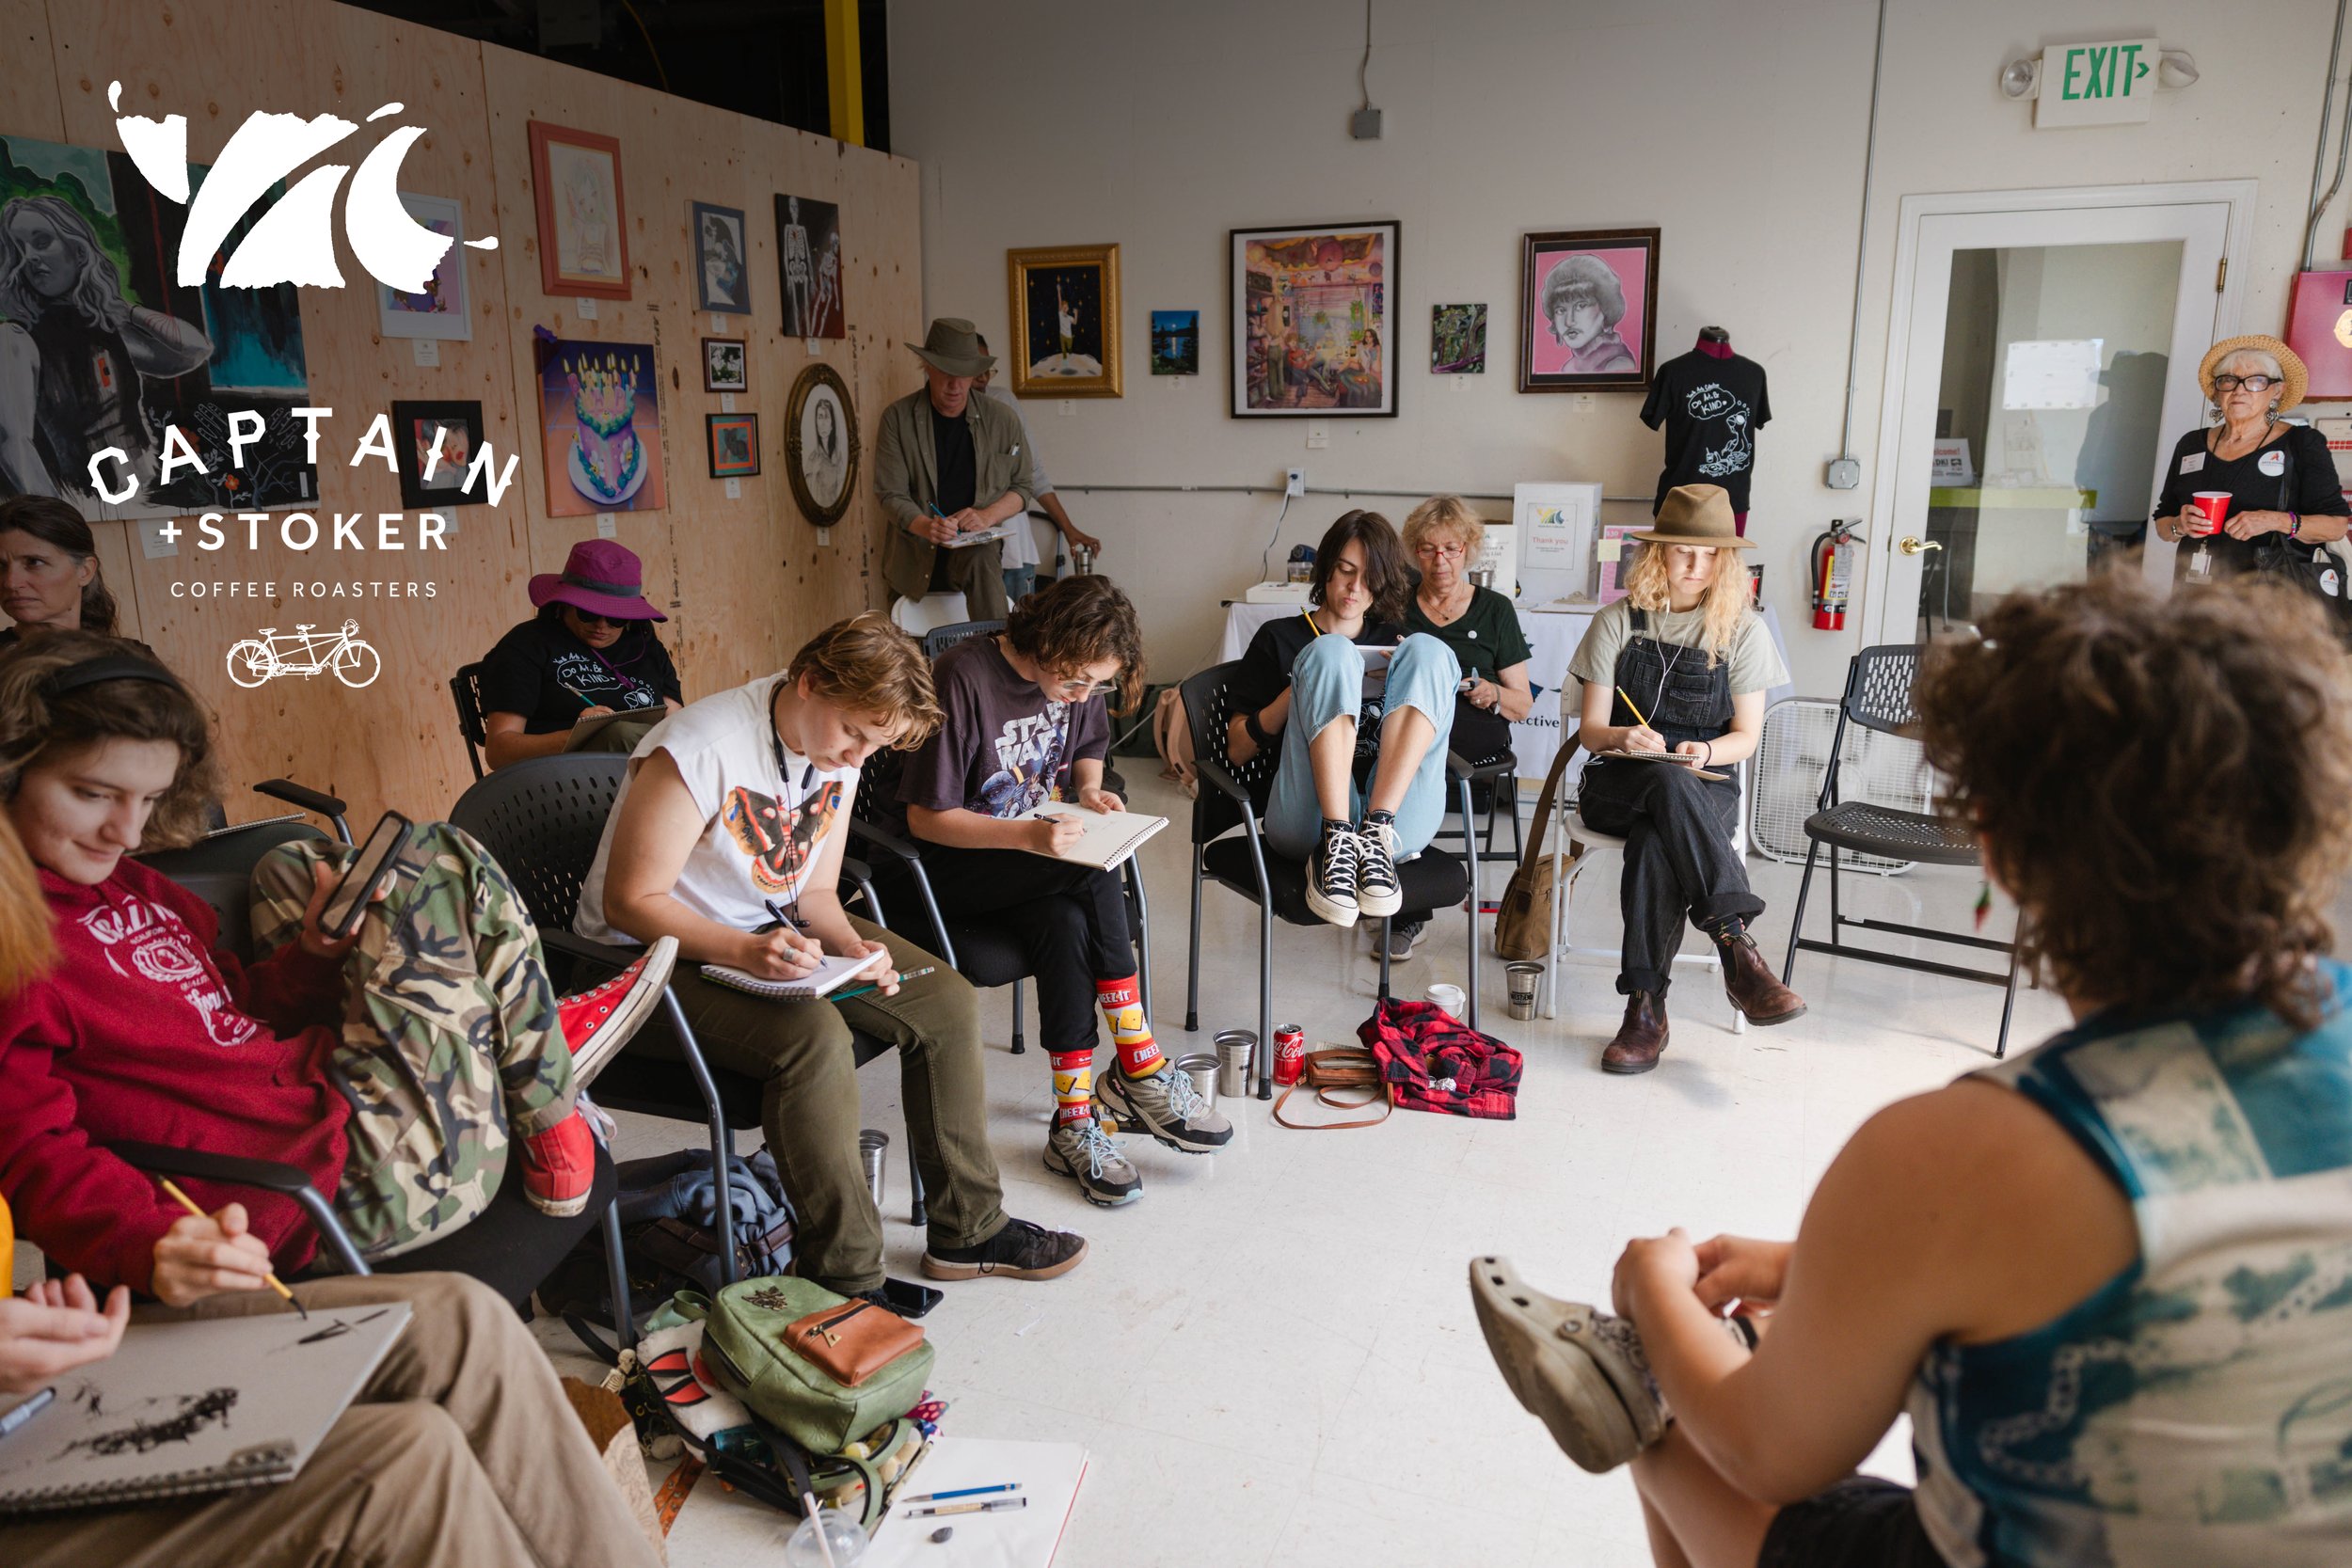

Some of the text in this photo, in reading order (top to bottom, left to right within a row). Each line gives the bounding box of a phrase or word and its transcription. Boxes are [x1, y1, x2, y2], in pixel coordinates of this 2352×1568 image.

[2062, 44, 2143, 101] EXIT
[562, 668, 577, 677] Do
[1517, 715, 1560, 728] ective
